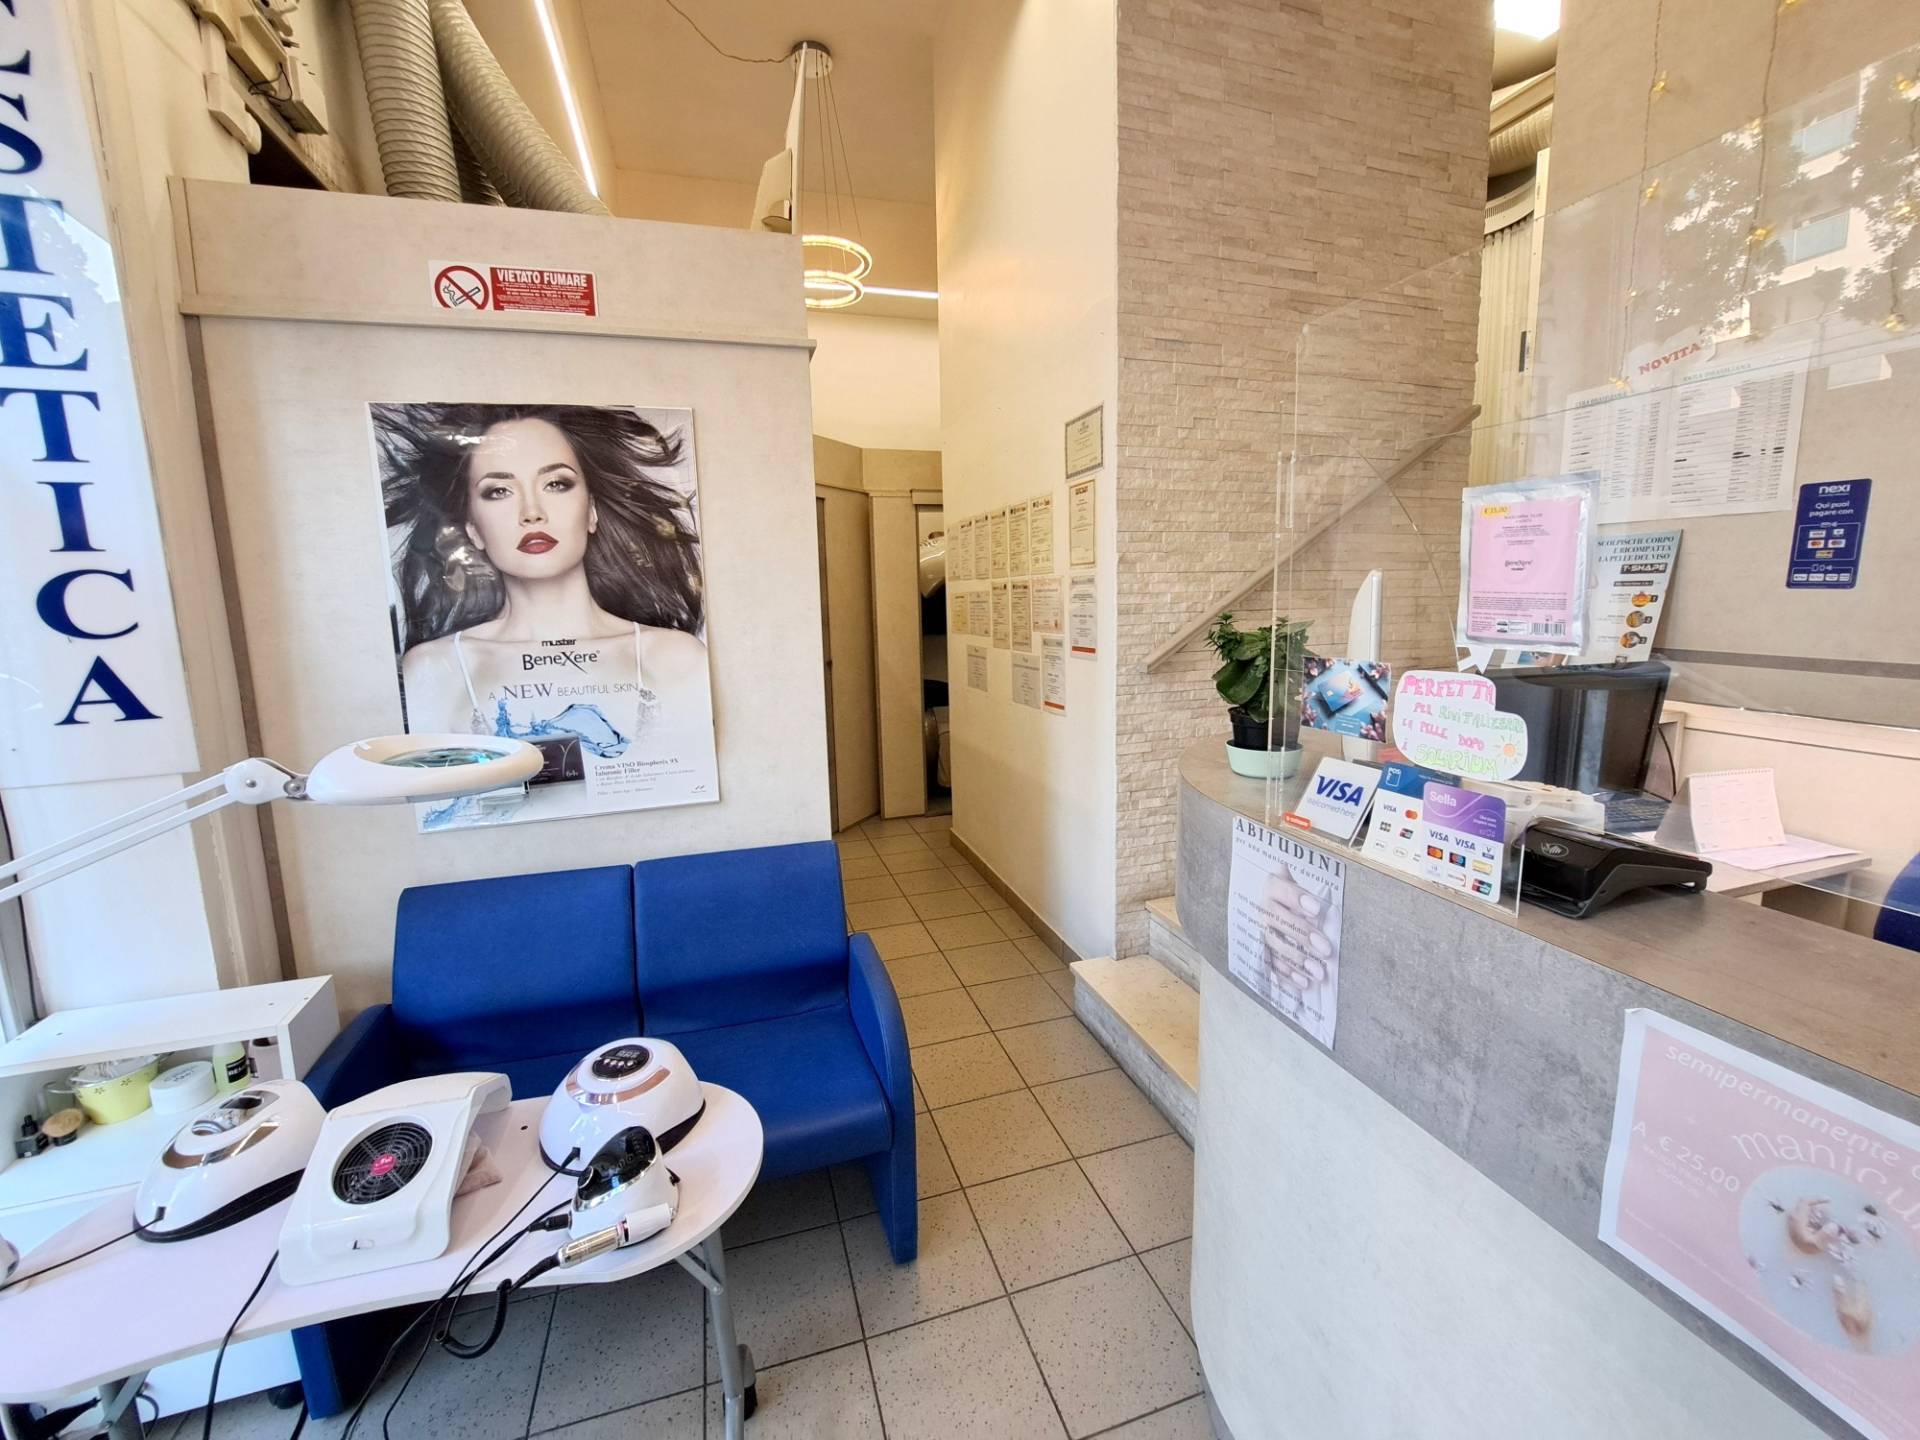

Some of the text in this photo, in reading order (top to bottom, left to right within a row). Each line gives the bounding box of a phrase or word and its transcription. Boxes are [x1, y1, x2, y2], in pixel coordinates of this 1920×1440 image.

[496, 268, 588, 287] VIETATO FUMARE
[1818, 484, 1851, 494] nexi
[1809, 509, 1836, 517] pagare
[1830, 501, 1850, 509] puoi
[1623, 563, 1666, 572] T-SHAPE
[541, 638, 577, 647] muster
[488, 681, 639, 701] A NEW BEAUTIFUL SKIN
[1420, 721, 1448, 739] PELLE
[1458, 734, 1485, 751] DOPO
[1316, 775, 1364, 806] VISA
[1429, 790, 1457, 807] Sella
[1383, 804, 1397, 813] VISA
[1235, 817, 1342, 878] ABITUDINI
[1429, 829, 1476, 851] VISA VISA
[1664, 1043, 1902, 1165] semipermanente
[1631, 1121, 1741, 1193] A € 25.00
